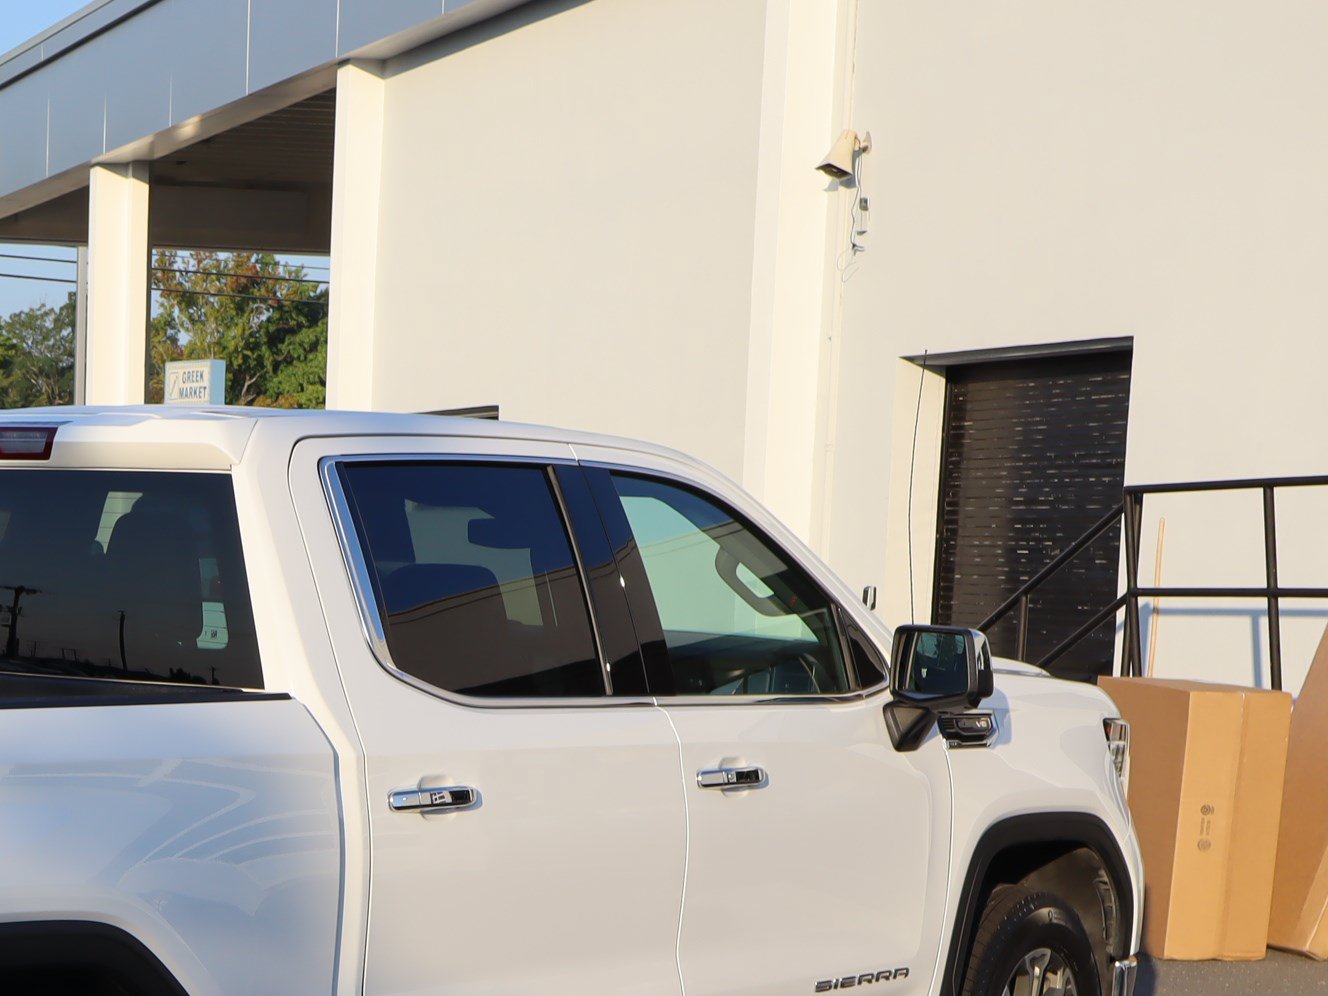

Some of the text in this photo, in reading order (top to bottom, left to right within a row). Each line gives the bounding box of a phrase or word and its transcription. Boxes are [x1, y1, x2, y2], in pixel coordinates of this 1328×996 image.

[182, 370, 205, 384] GREEK
[178, 386, 207, 399] MARKET
[815, 967, 910, 993] SIERRA
